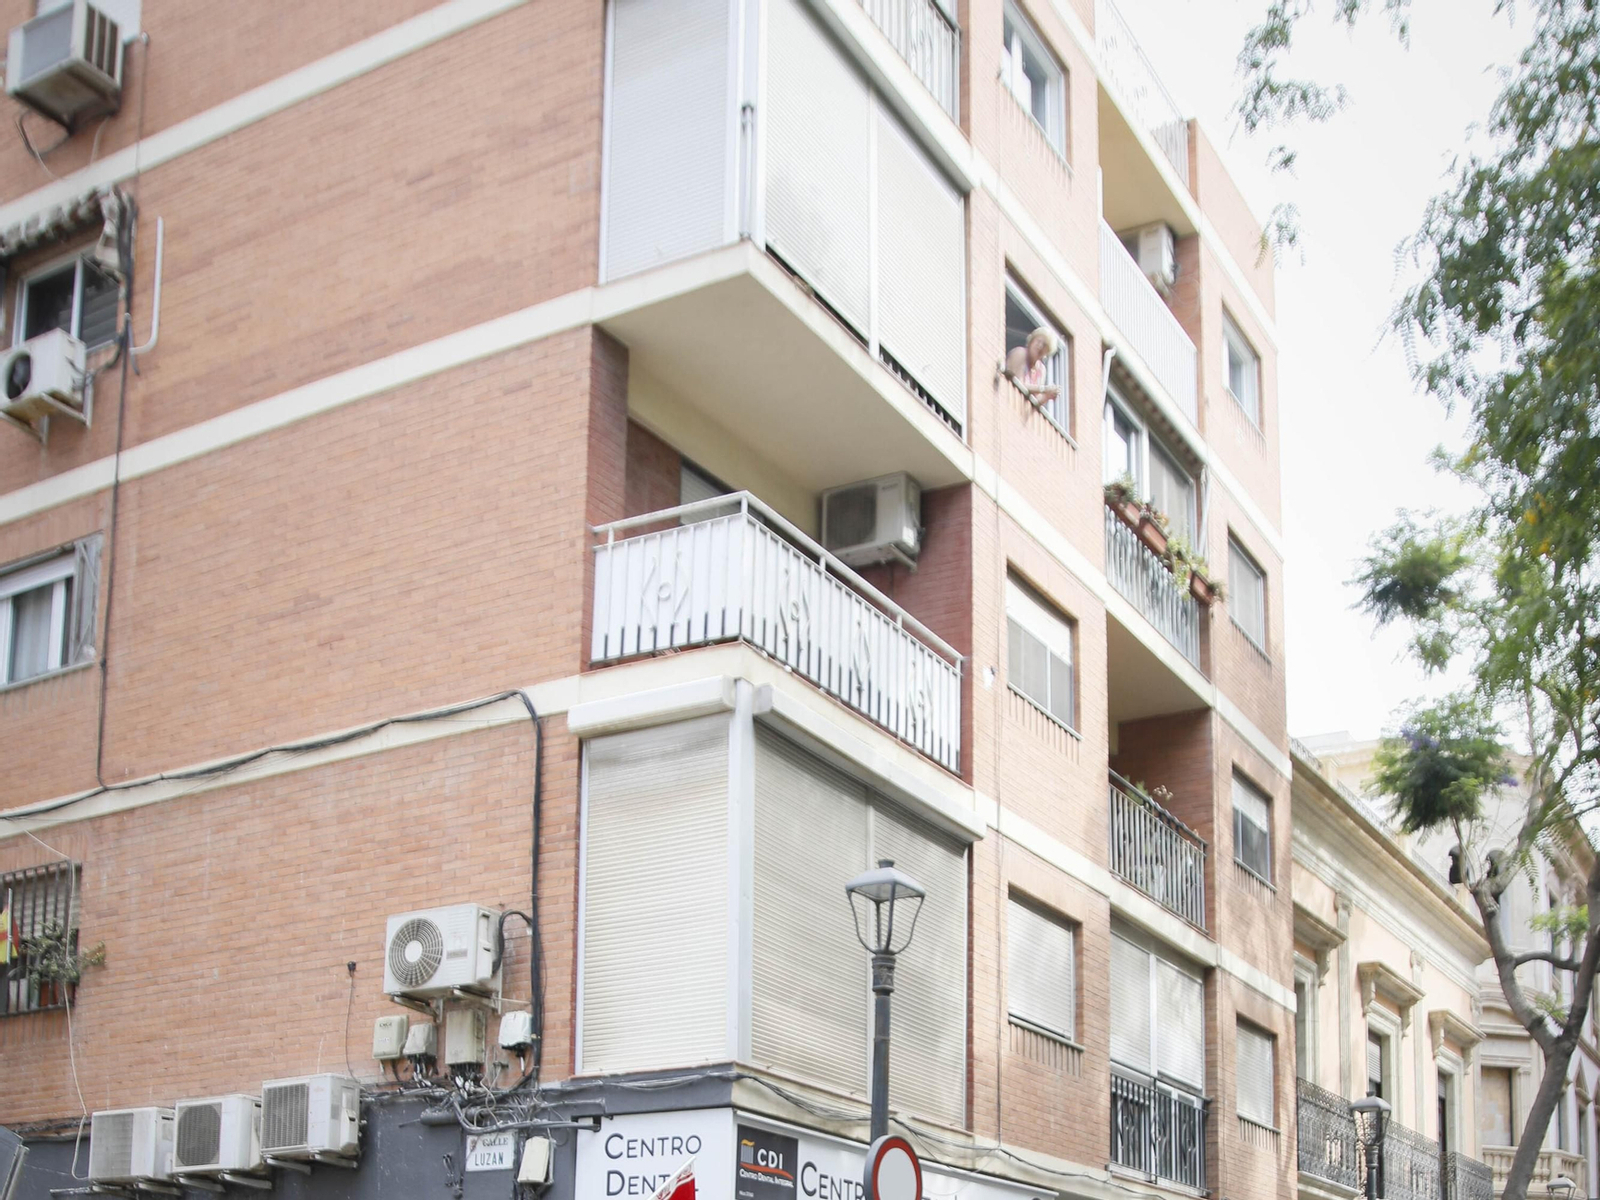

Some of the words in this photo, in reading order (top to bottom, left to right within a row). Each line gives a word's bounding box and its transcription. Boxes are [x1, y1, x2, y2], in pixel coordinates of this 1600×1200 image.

[483, 1137, 508, 1147] CALLE
[605, 1133, 702, 1159] CENTRO
[475, 1152, 504, 1166] LUZAN
[757, 1148, 782, 1170] CDI
[606, 1170, 699, 1196] DENT
